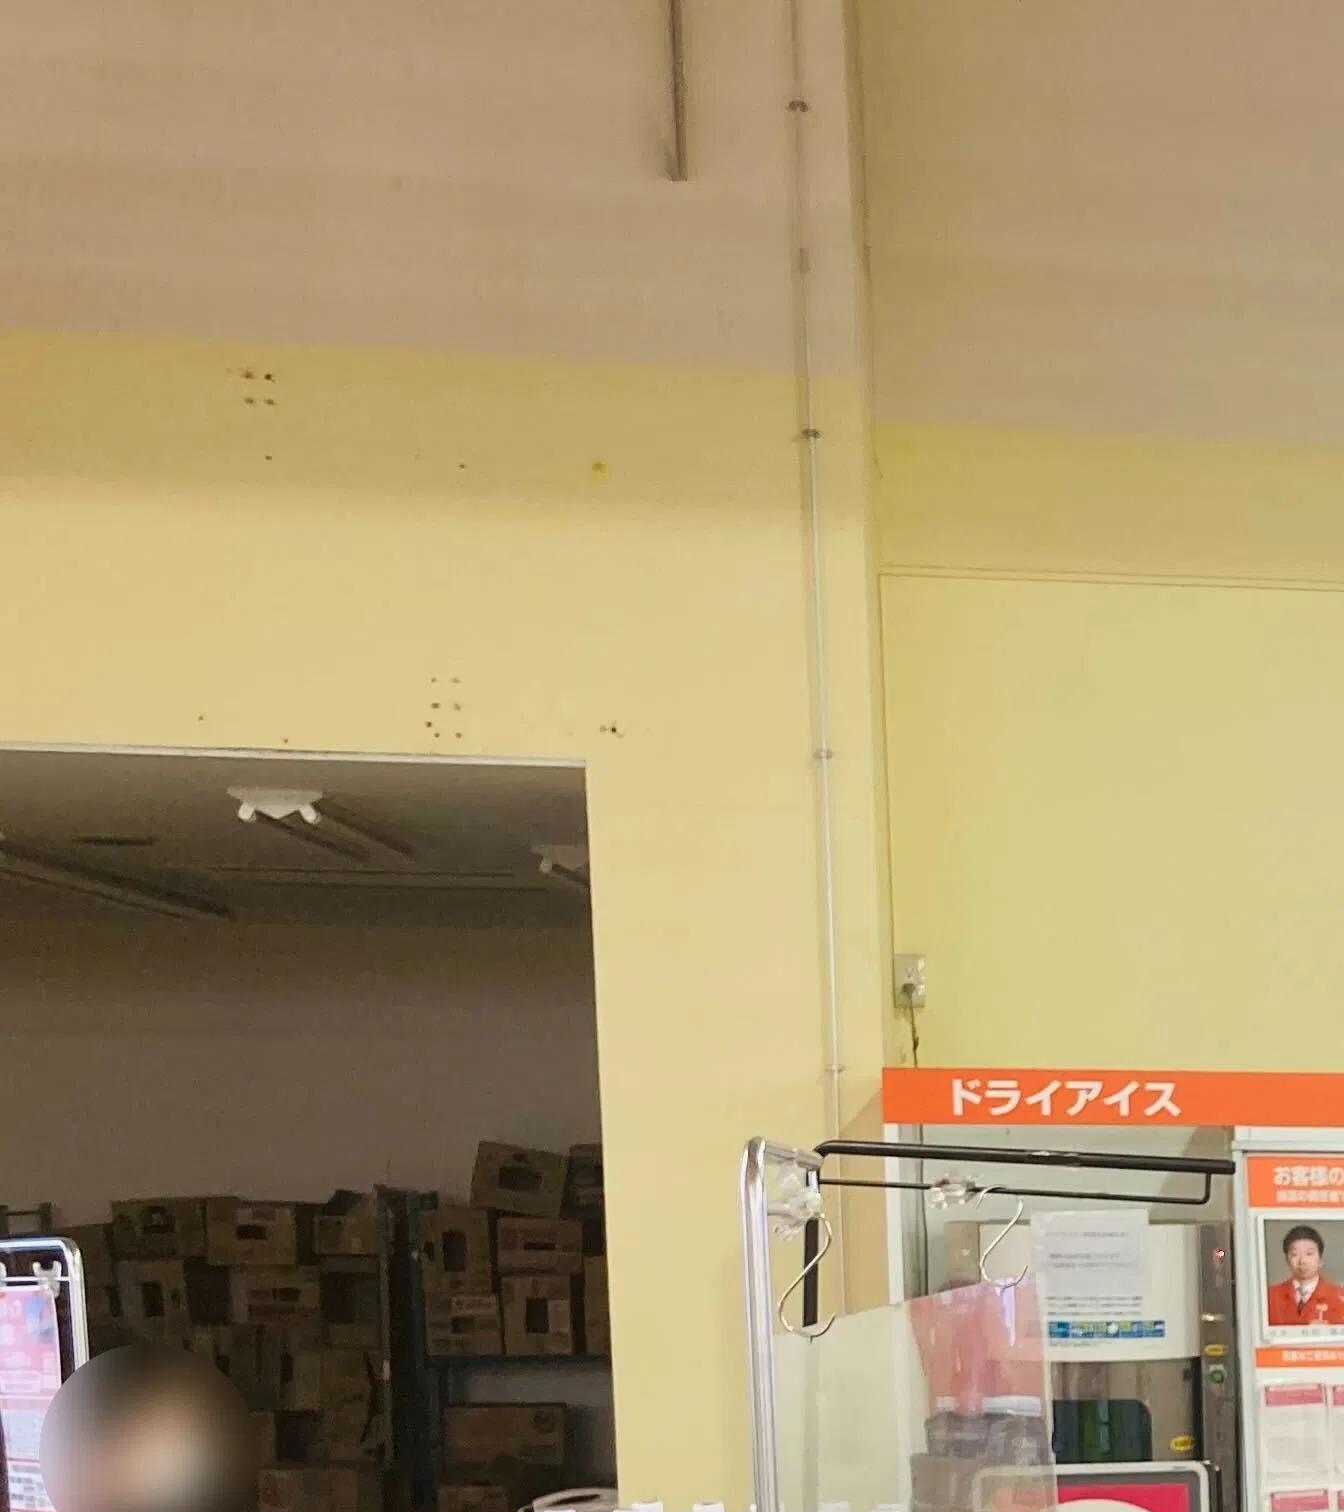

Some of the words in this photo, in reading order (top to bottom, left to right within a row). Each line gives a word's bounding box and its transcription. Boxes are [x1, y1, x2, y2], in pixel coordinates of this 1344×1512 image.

[952, 1078, 1182, 1117] ドライアイス
